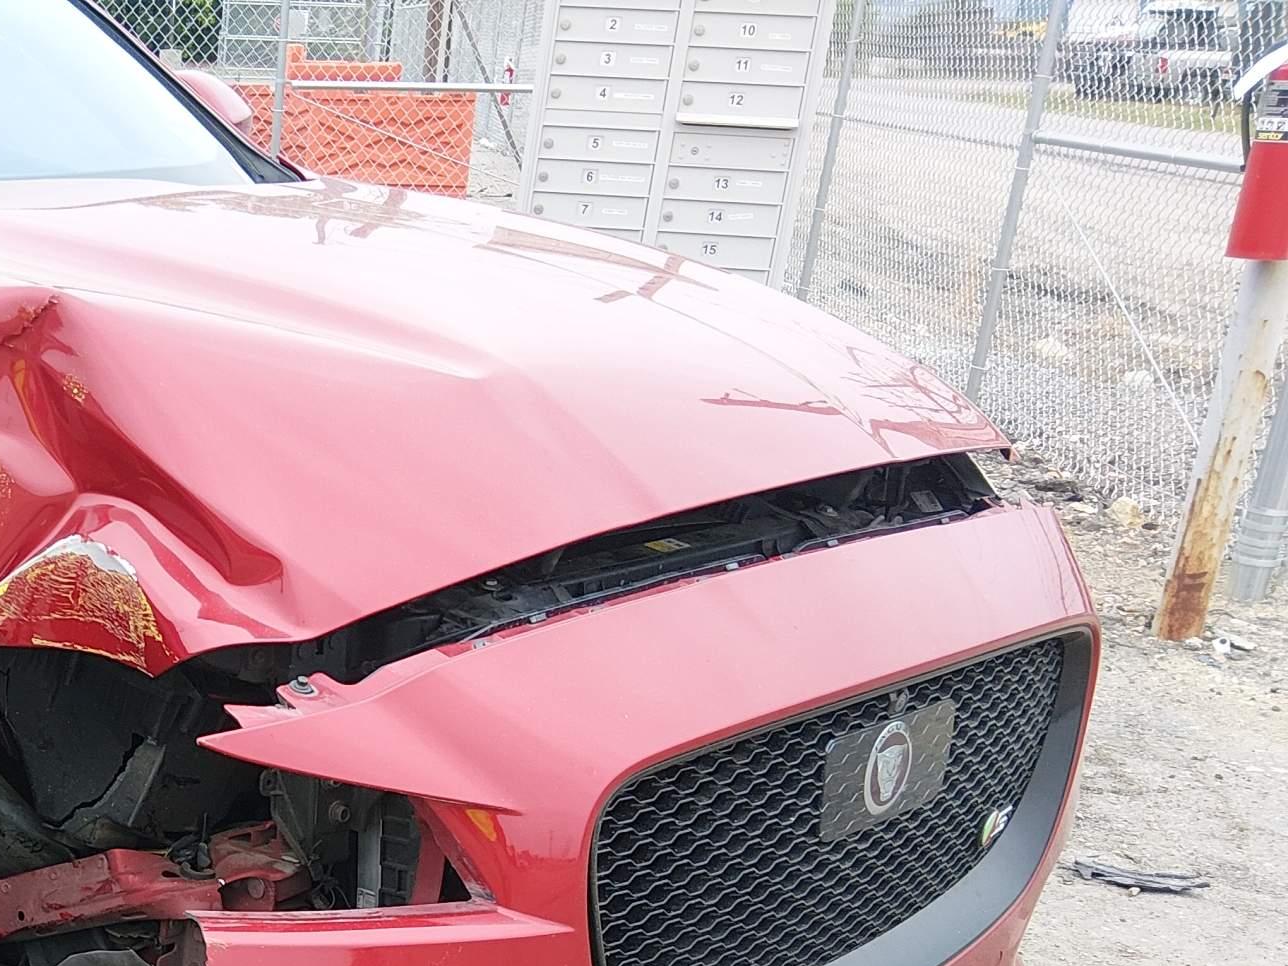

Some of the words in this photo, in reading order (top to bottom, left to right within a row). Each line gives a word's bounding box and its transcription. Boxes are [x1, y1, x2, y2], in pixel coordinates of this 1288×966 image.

[609, 19, 618, 30] 2
[742, 25, 756, 36] 10
[604, 53, 612, 65] 3
[736, 60, 749, 71] 11
[599, 87, 608, 98] 4
[730, 94, 744, 106] 12
[591, 136, 600, 149] 5
[586, 171, 594, 183] 6
[715, 178, 729, 190] 13
[581, 204, 589, 215] 7
[709, 211, 723, 222] 14
[702, 242, 717, 255] 15
